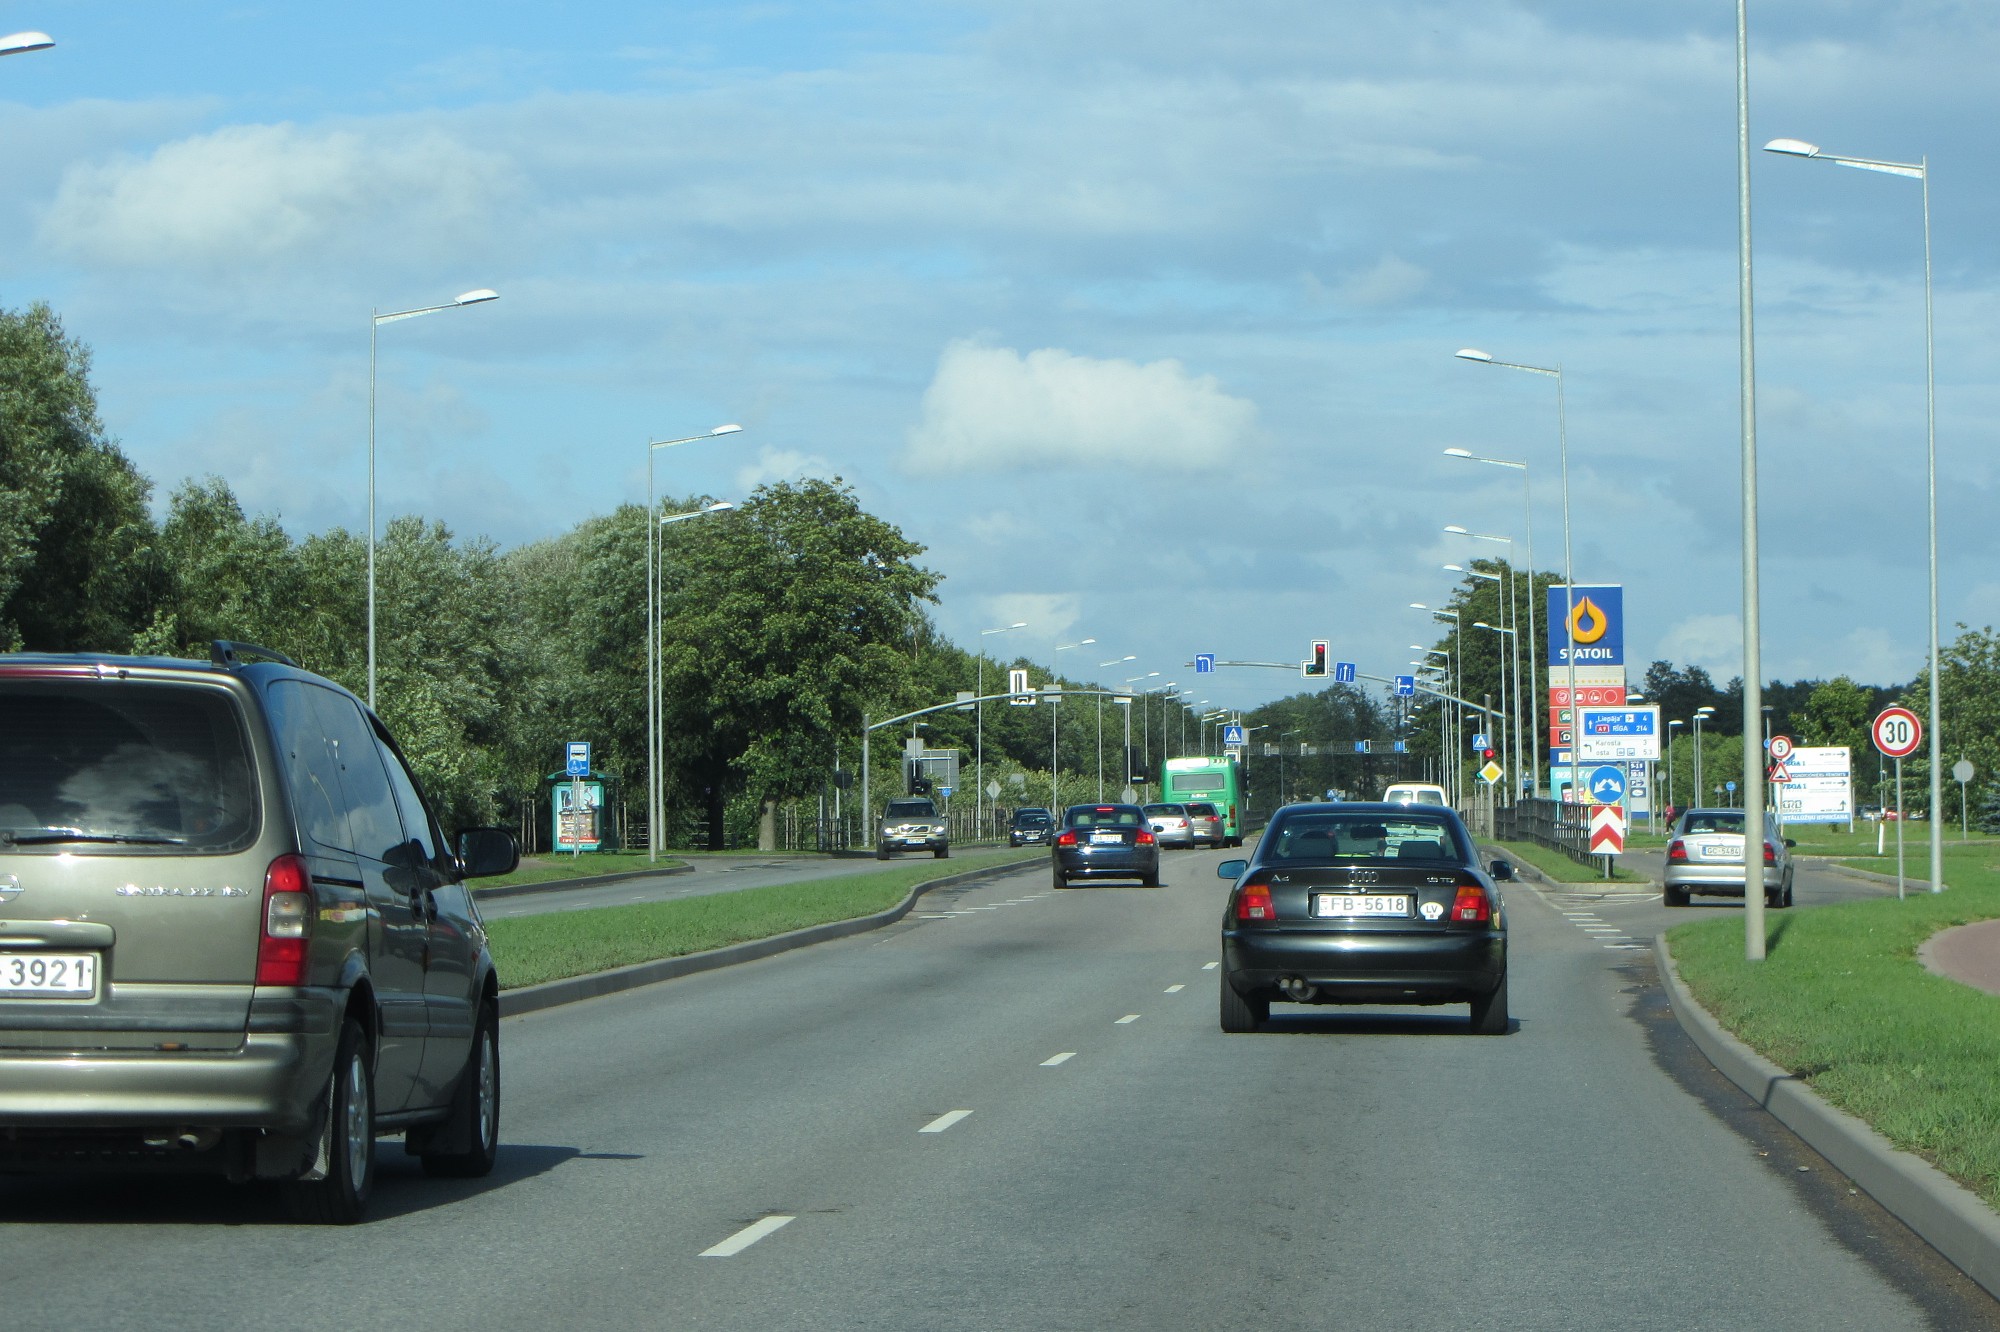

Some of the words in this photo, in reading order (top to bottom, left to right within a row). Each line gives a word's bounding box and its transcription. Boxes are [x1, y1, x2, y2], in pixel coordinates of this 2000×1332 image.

[1559, 648, 1613, 659] SATOIL
[1885, 721, 1907, 743] 30
[1777, 741, 1783, 752] 5
[1331, 898, 1404, 911] FB-5618
[1426, 905, 1438, 913] LV
